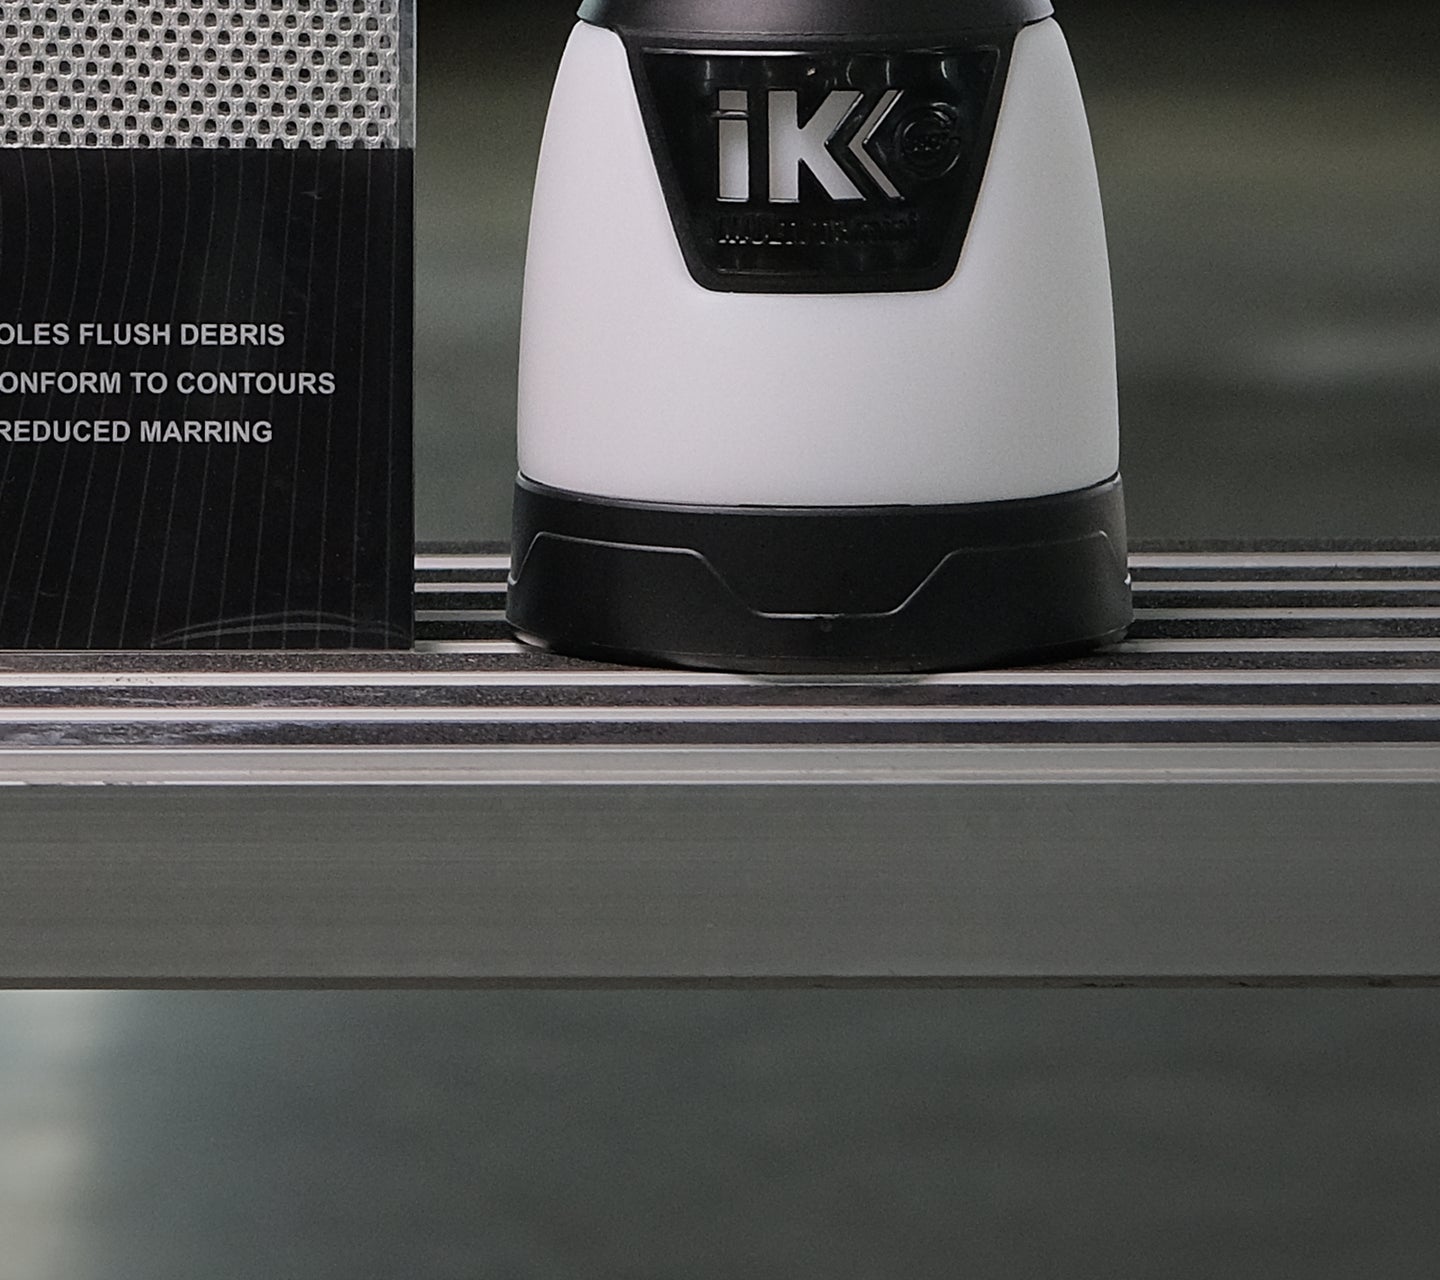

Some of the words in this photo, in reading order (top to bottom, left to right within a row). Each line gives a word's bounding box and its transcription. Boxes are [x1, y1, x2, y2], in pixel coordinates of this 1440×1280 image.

[79, 322, 171, 346] FLUSH
[180, 323, 285, 346] DEBRIS
[129, 372, 168, 394] TO
[176, 372, 336, 395] CONTOURS
[140, 420, 273, 443] MARRING
